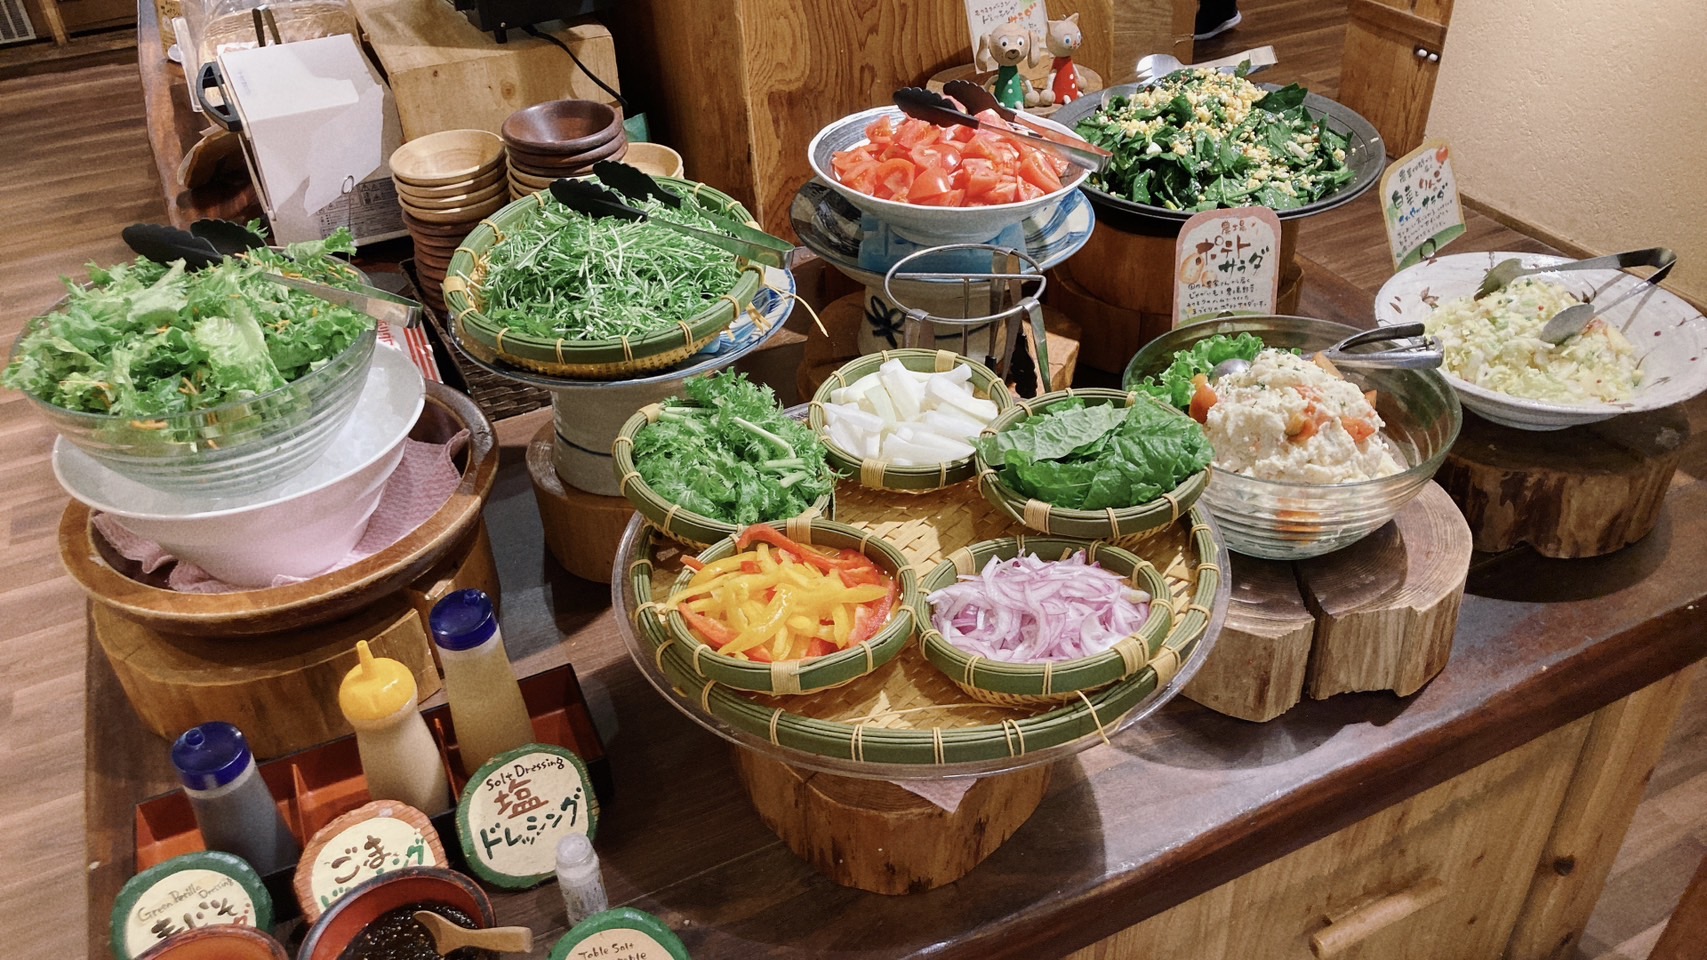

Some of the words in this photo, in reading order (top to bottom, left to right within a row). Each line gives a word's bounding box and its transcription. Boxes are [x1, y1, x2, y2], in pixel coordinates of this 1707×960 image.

[1195, 234, 1252, 266] ポテト
[1218, 245, 1270, 280] サラダ
[513, 756, 565, 778] Dressing
[493, 778, 550, 820] 塩
[479, 786, 583, 861] ドレッシング
[330, 834, 392, 885] ごま
[136, 901, 174, 923] Green
